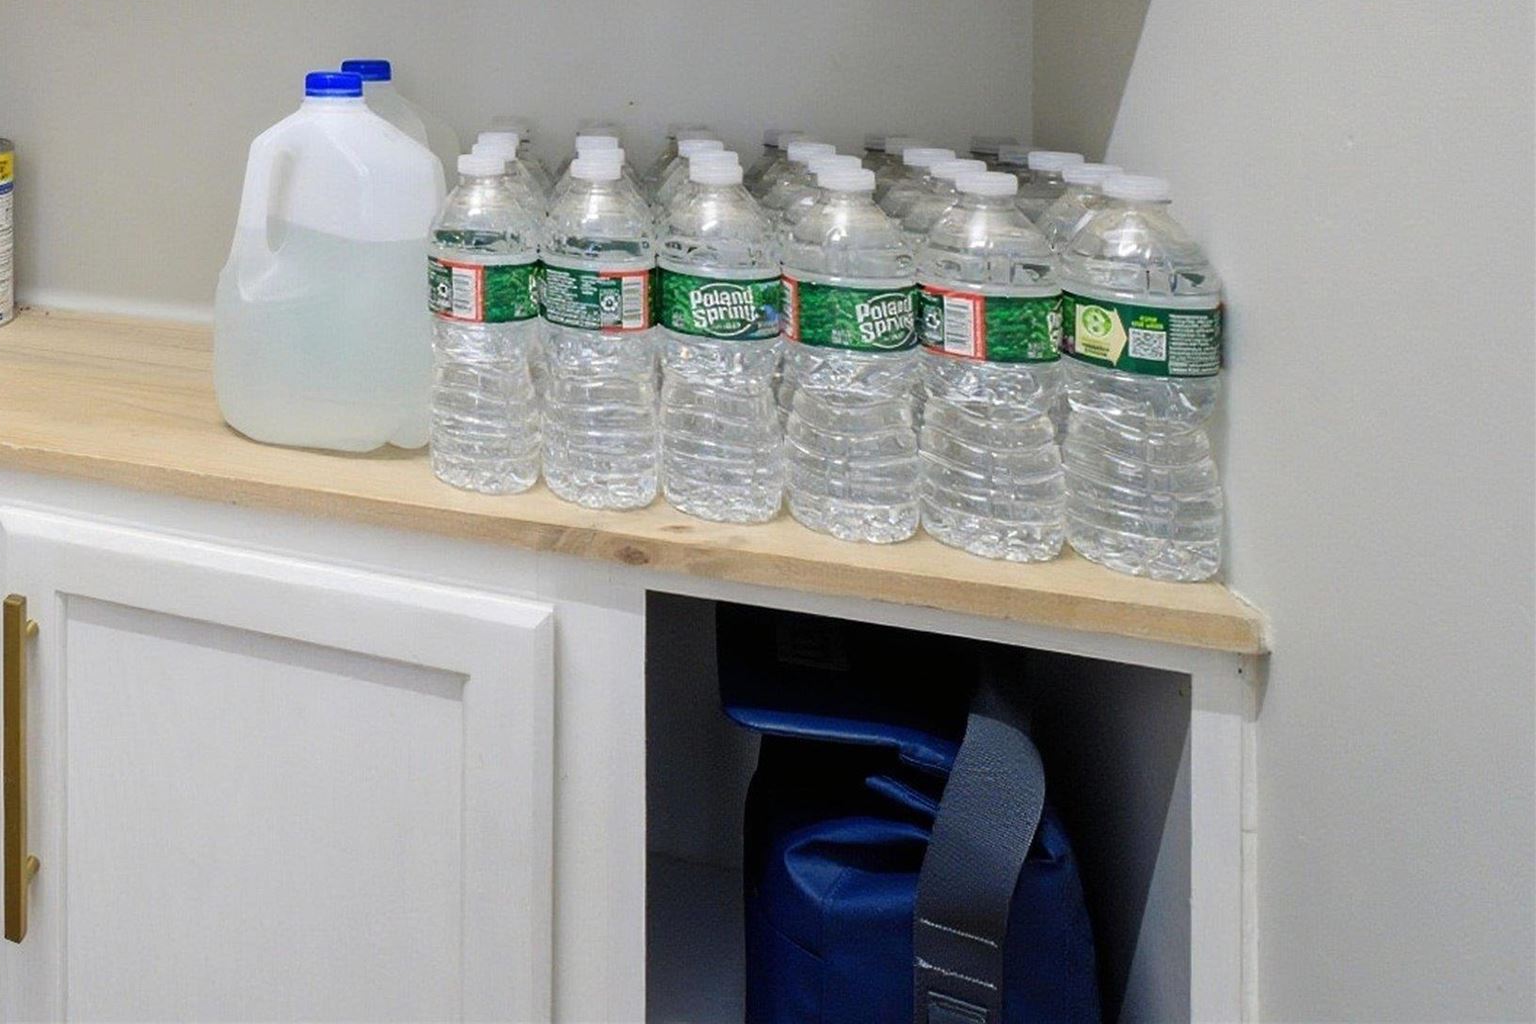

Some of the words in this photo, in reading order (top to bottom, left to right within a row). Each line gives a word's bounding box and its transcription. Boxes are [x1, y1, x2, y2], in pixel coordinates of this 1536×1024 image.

[689, 285, 754, 310] Poland
[855, 294, 912, 323] Poland
[691, 303, 758, 328] Spring
